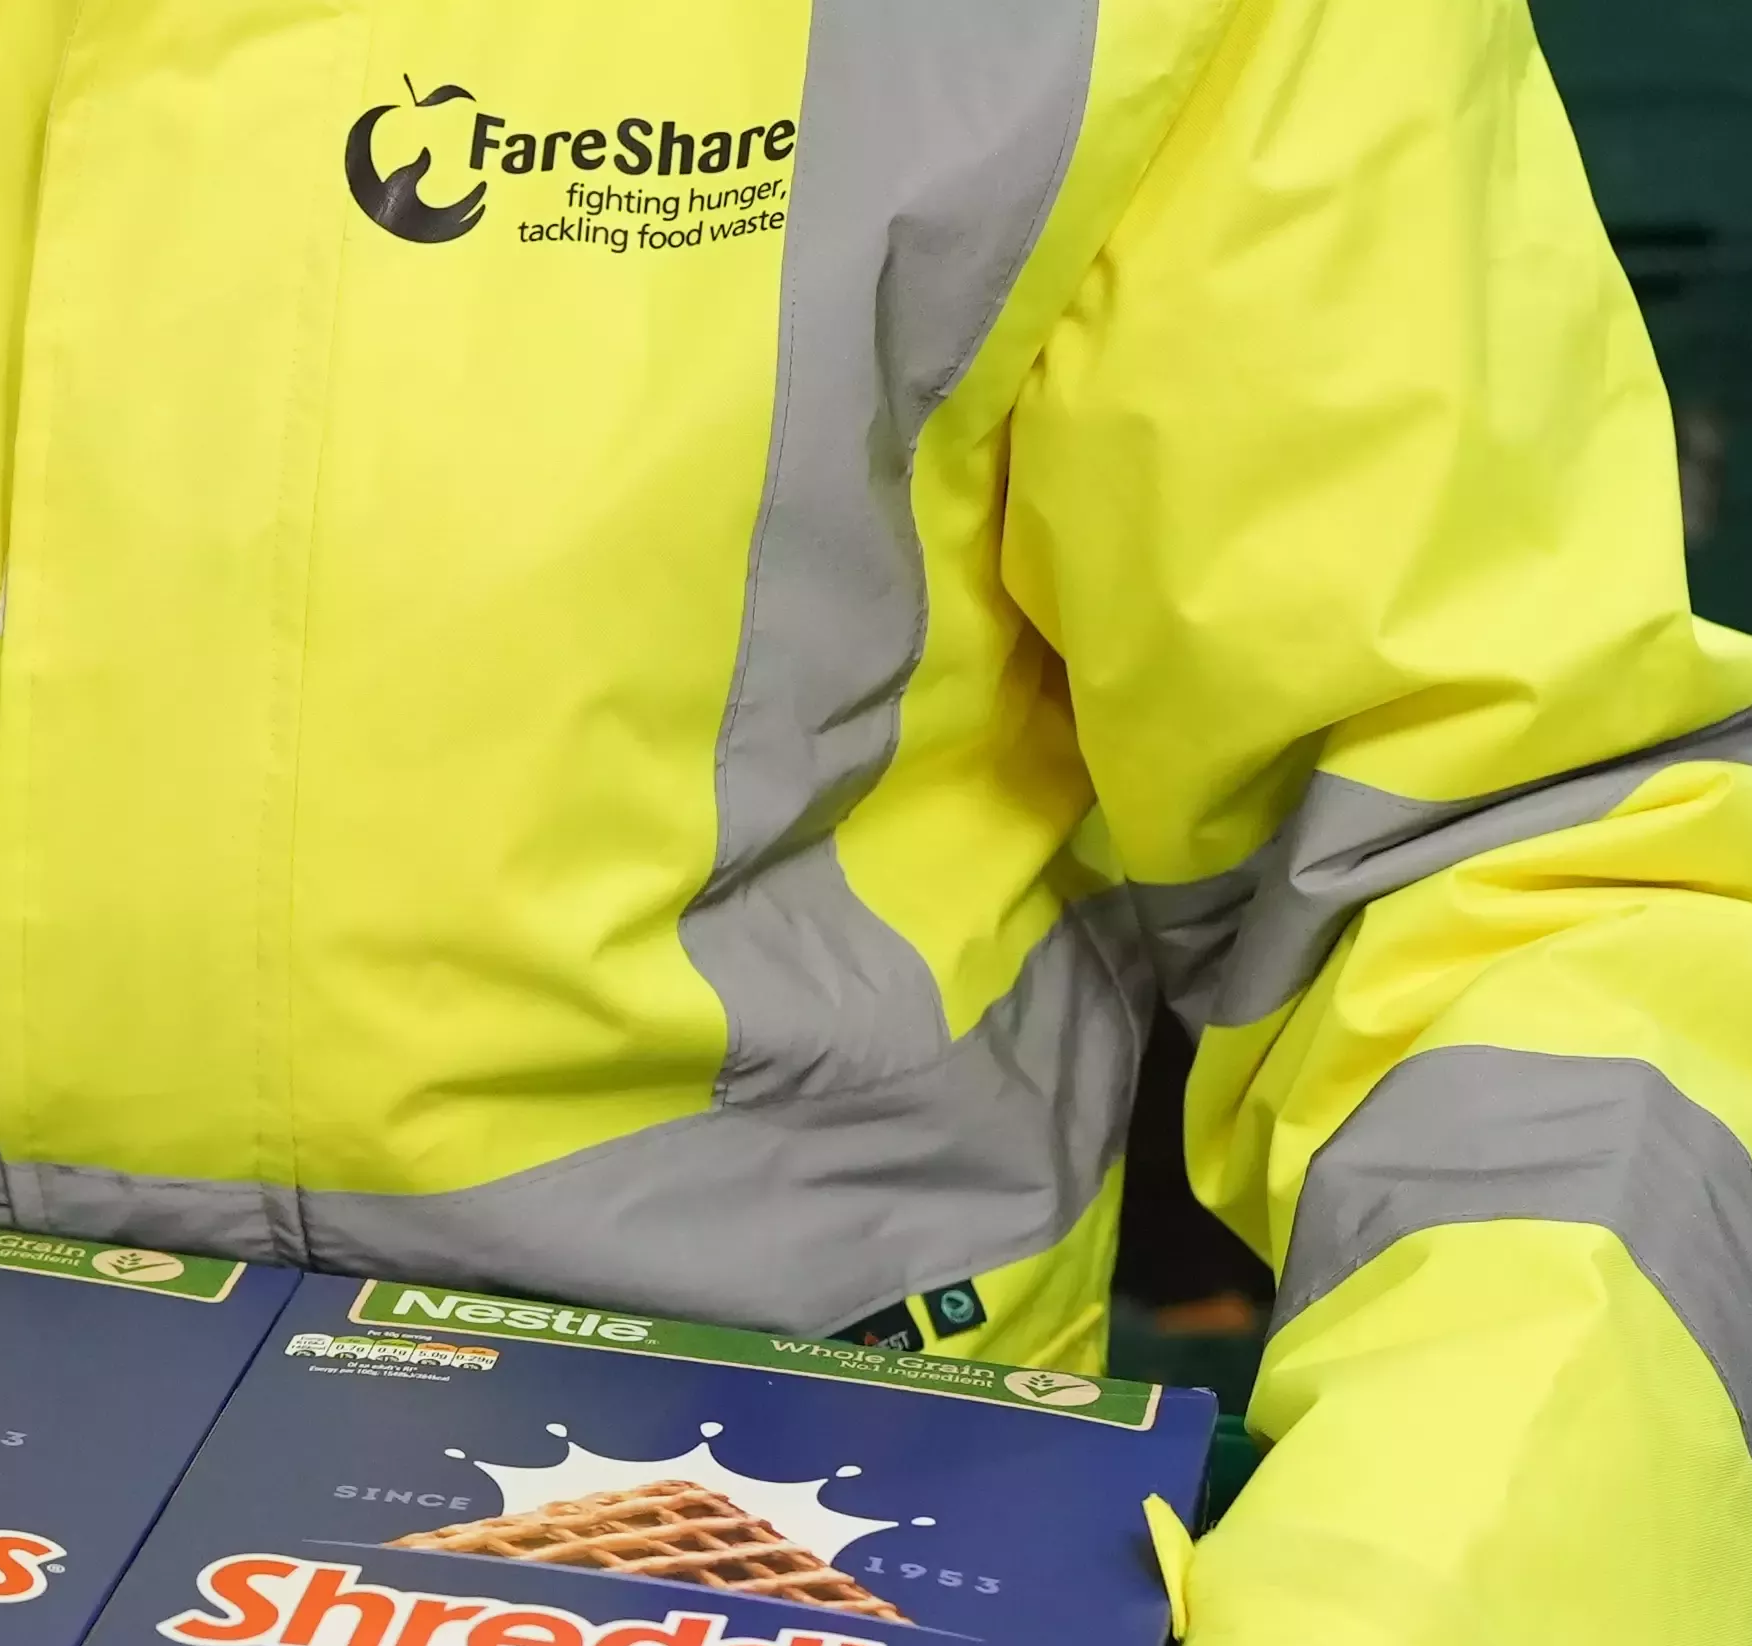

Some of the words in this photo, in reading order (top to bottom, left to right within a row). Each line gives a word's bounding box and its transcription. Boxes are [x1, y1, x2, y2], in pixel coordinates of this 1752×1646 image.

[469, 112, 796, 177] FareShare
[565, 182, 681, 221] fighting
[687, 177, 787, 215] hunger,
[518, 218, 629, 253] tackling
[637, 221, 704, 250] food
[708, 209, 785, 242] waste
[392, 1290, 653, 1342] Nestlé
[770, 1340, 885, 1364] Whole
[896, 1356, 995, 1379] Grain
[887, 1367, 993, 1388] ingredient
[333, 1484, 472, 1512] SINCE
[863, 1555, 1002, 1594] 1953
